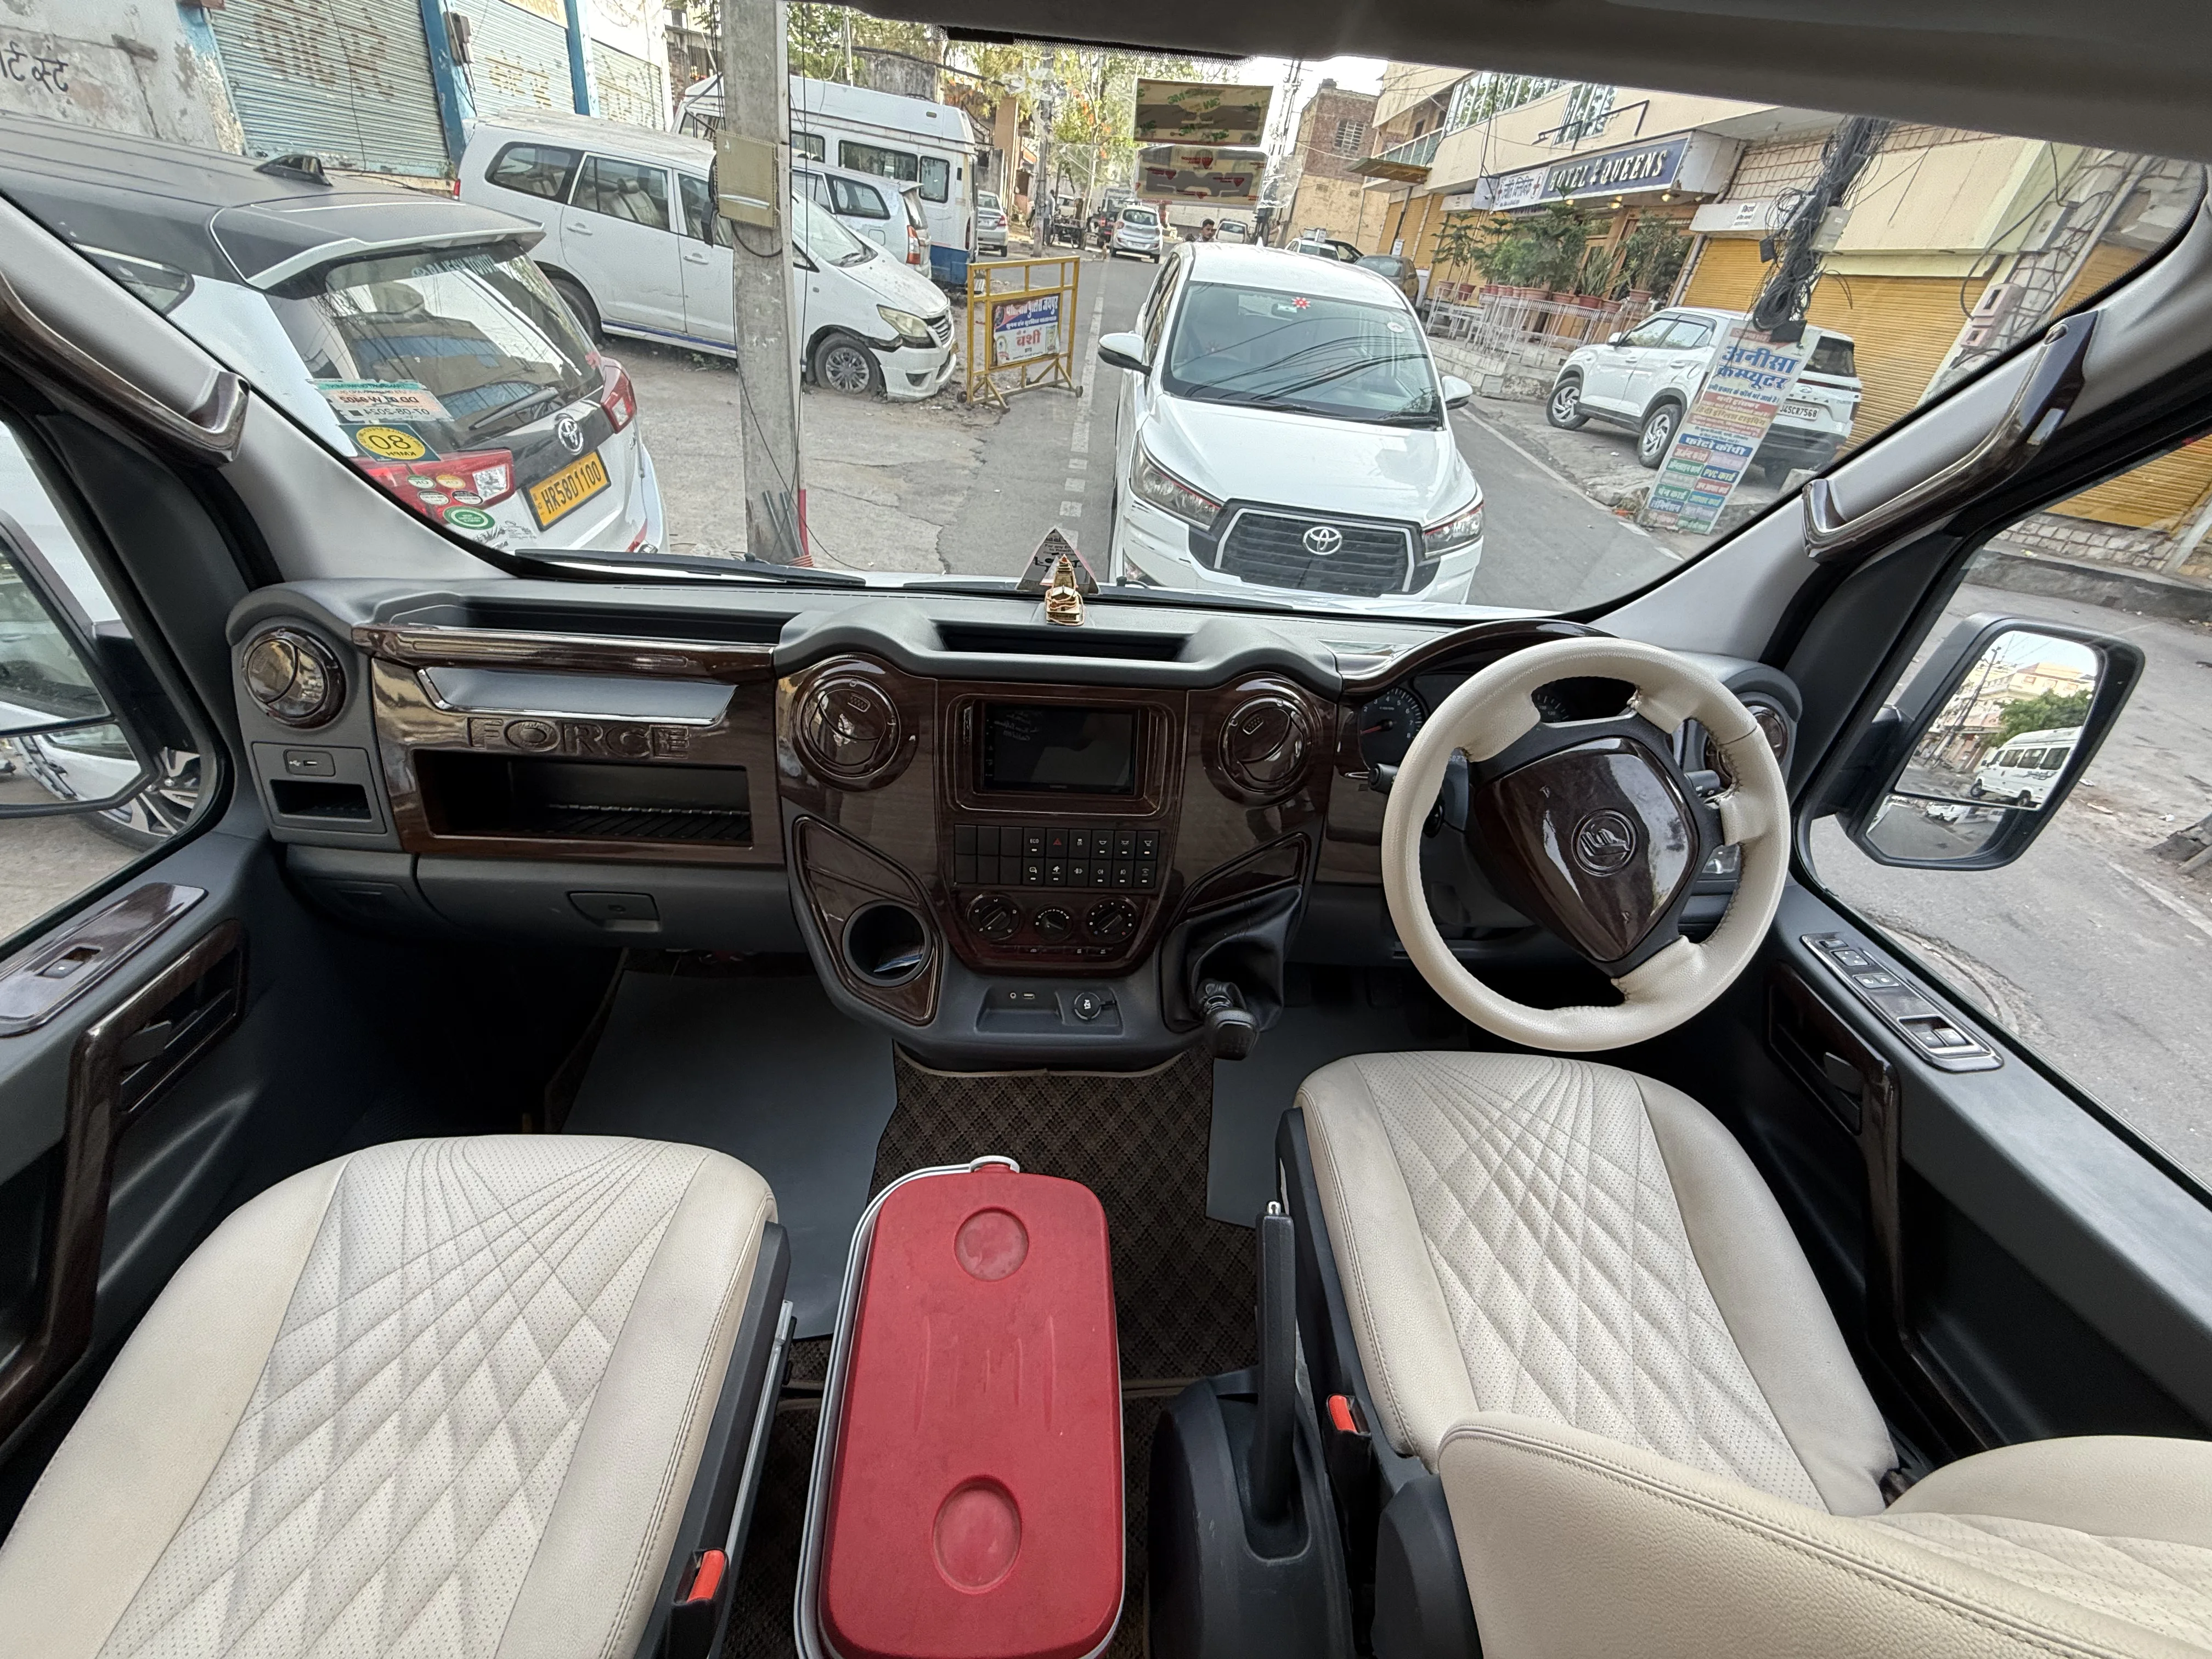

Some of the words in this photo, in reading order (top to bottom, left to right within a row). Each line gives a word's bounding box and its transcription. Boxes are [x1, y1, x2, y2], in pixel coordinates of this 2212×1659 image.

[1548, 165, 1590, 192] HOTEL
[1601, 149, 1668, 185] QUEENS
[1042, 296, 1059, 315] जयपुर
[1722, 346, 1801, 374] अनीसा
[1717, 385, 1734, 393] प्रकार
[1683, 436, 1716, 449] फोटो
[1713, 442, 1748, 455] कॉपी
[1702, 469, 1719, 477] PVC
[1716, 470, 1737, 481] कार्ड
[541, 460, 602, 515] HR58D1100
[1668, 488, 1688, 499] कार्ड
[467, 716, 690, 759] FORCE
